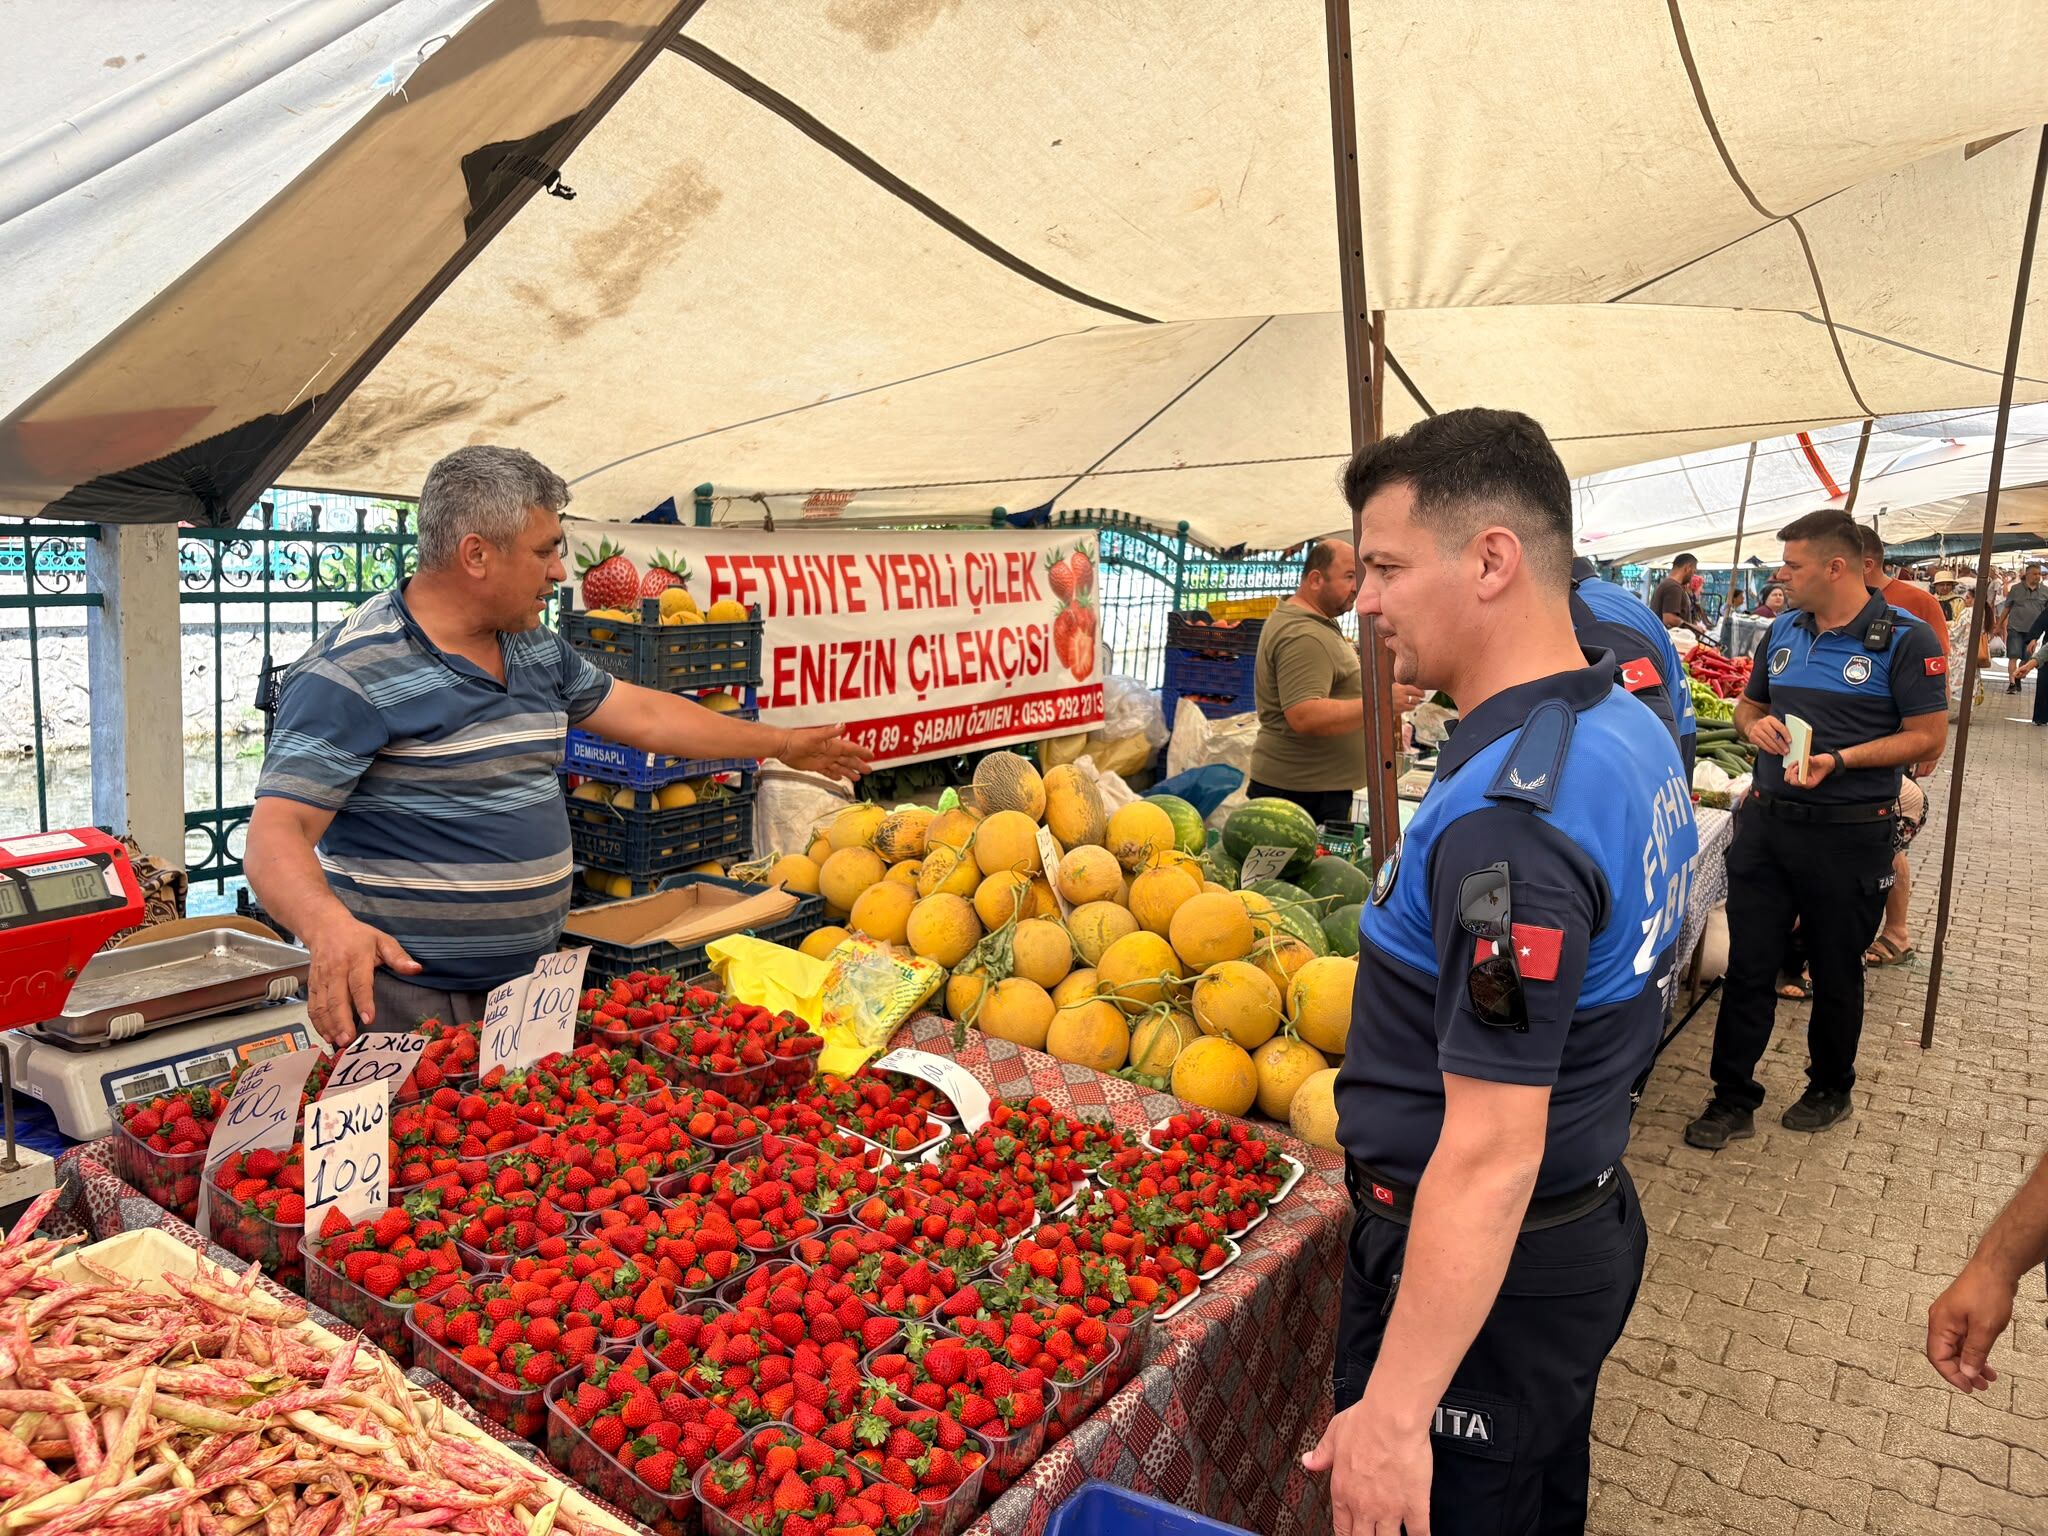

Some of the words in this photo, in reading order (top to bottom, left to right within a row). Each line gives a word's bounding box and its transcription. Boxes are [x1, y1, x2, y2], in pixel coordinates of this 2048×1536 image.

[880, 725, 900, 752] 89
[912, 713, 966, 753] ŞABAN
[966, 704, 1013, 737] ÖZMEN
[1022, 699, 1055, 727] 0535
[1056, 695, 1080, 720] 292
[26, 865, 58, 875] TOPLAM
[527, 986, 575, 1023] 100
[327, 1057, 402, 1089] 100
[226, 1083, 282, 1127] 100
[305, 1152, 382, 1210] 100
[1431, 1406, 1489, 1441] ITA
